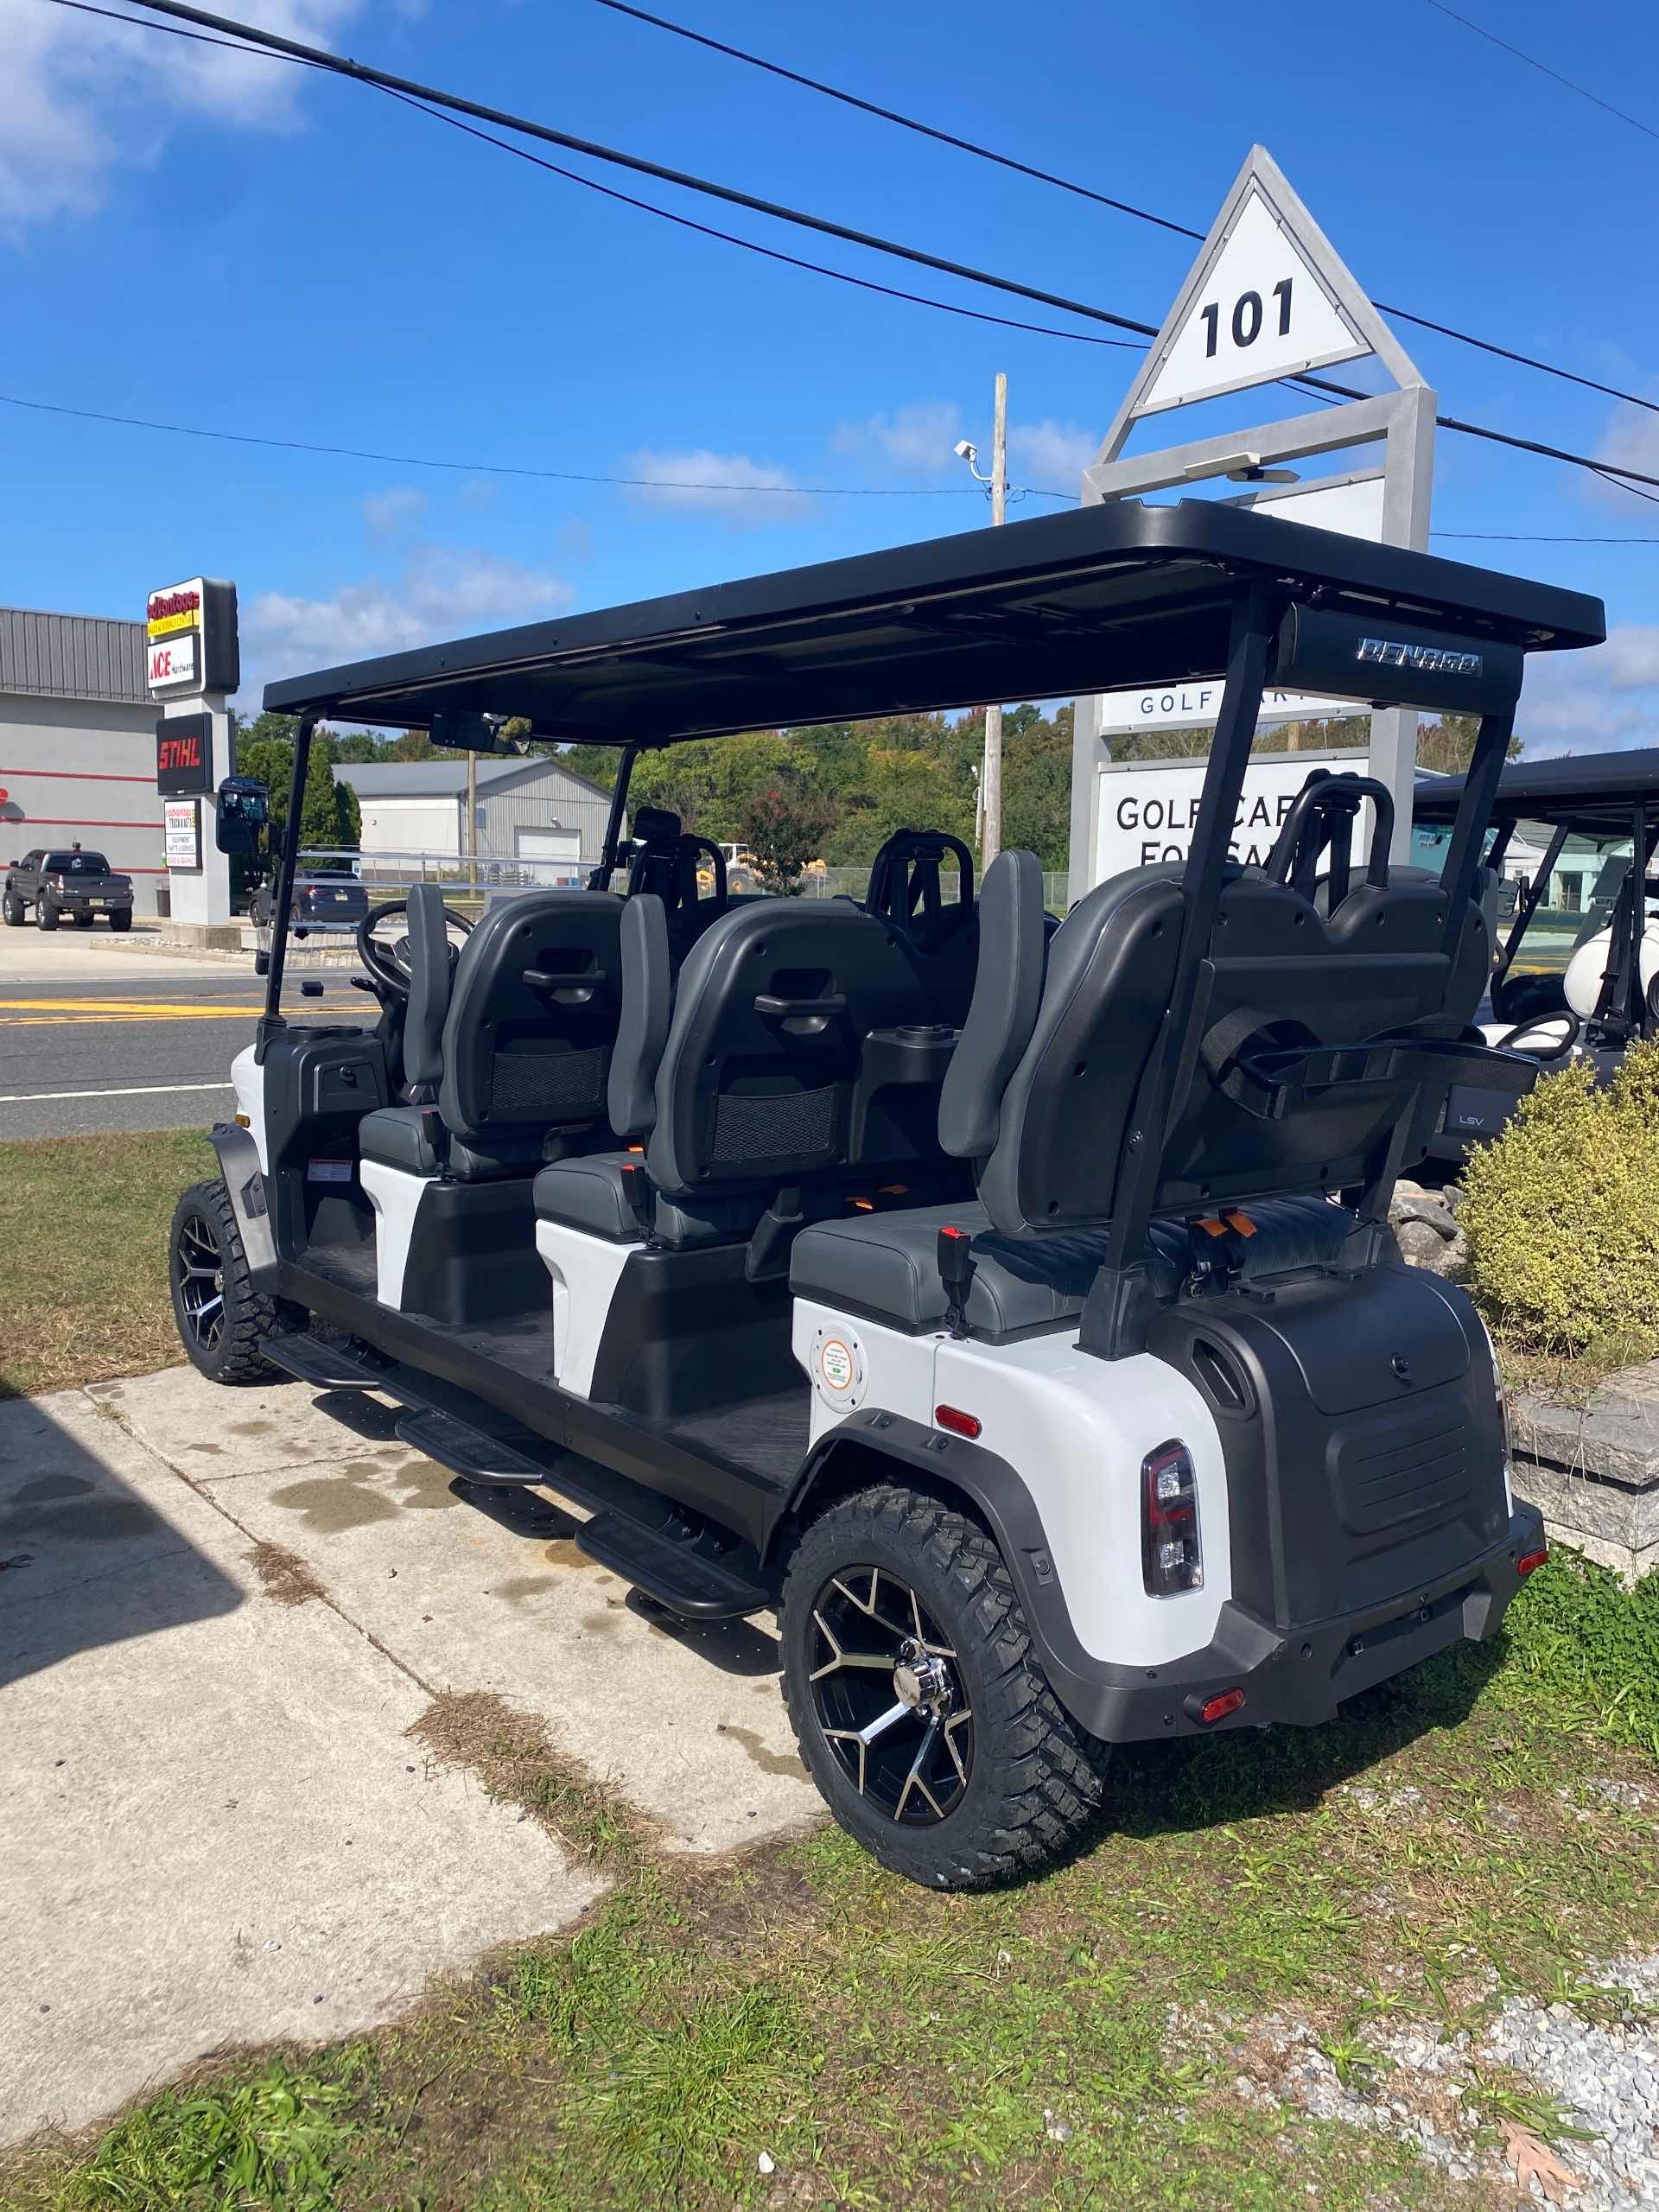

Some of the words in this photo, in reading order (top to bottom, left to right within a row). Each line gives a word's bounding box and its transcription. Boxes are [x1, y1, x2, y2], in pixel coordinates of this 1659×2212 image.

[1200, 276, 1293, 358] 101
[150, 651, 171, 680] ACE
[172, 663, 194, 675] Hardware
[1141, 691, 1212, 714] GOLF
[159, 737, 200, 770] STIHL
[1116, 797, 1202, 830] GOLF
[1459, 1115, 1484, 1126] LSV
